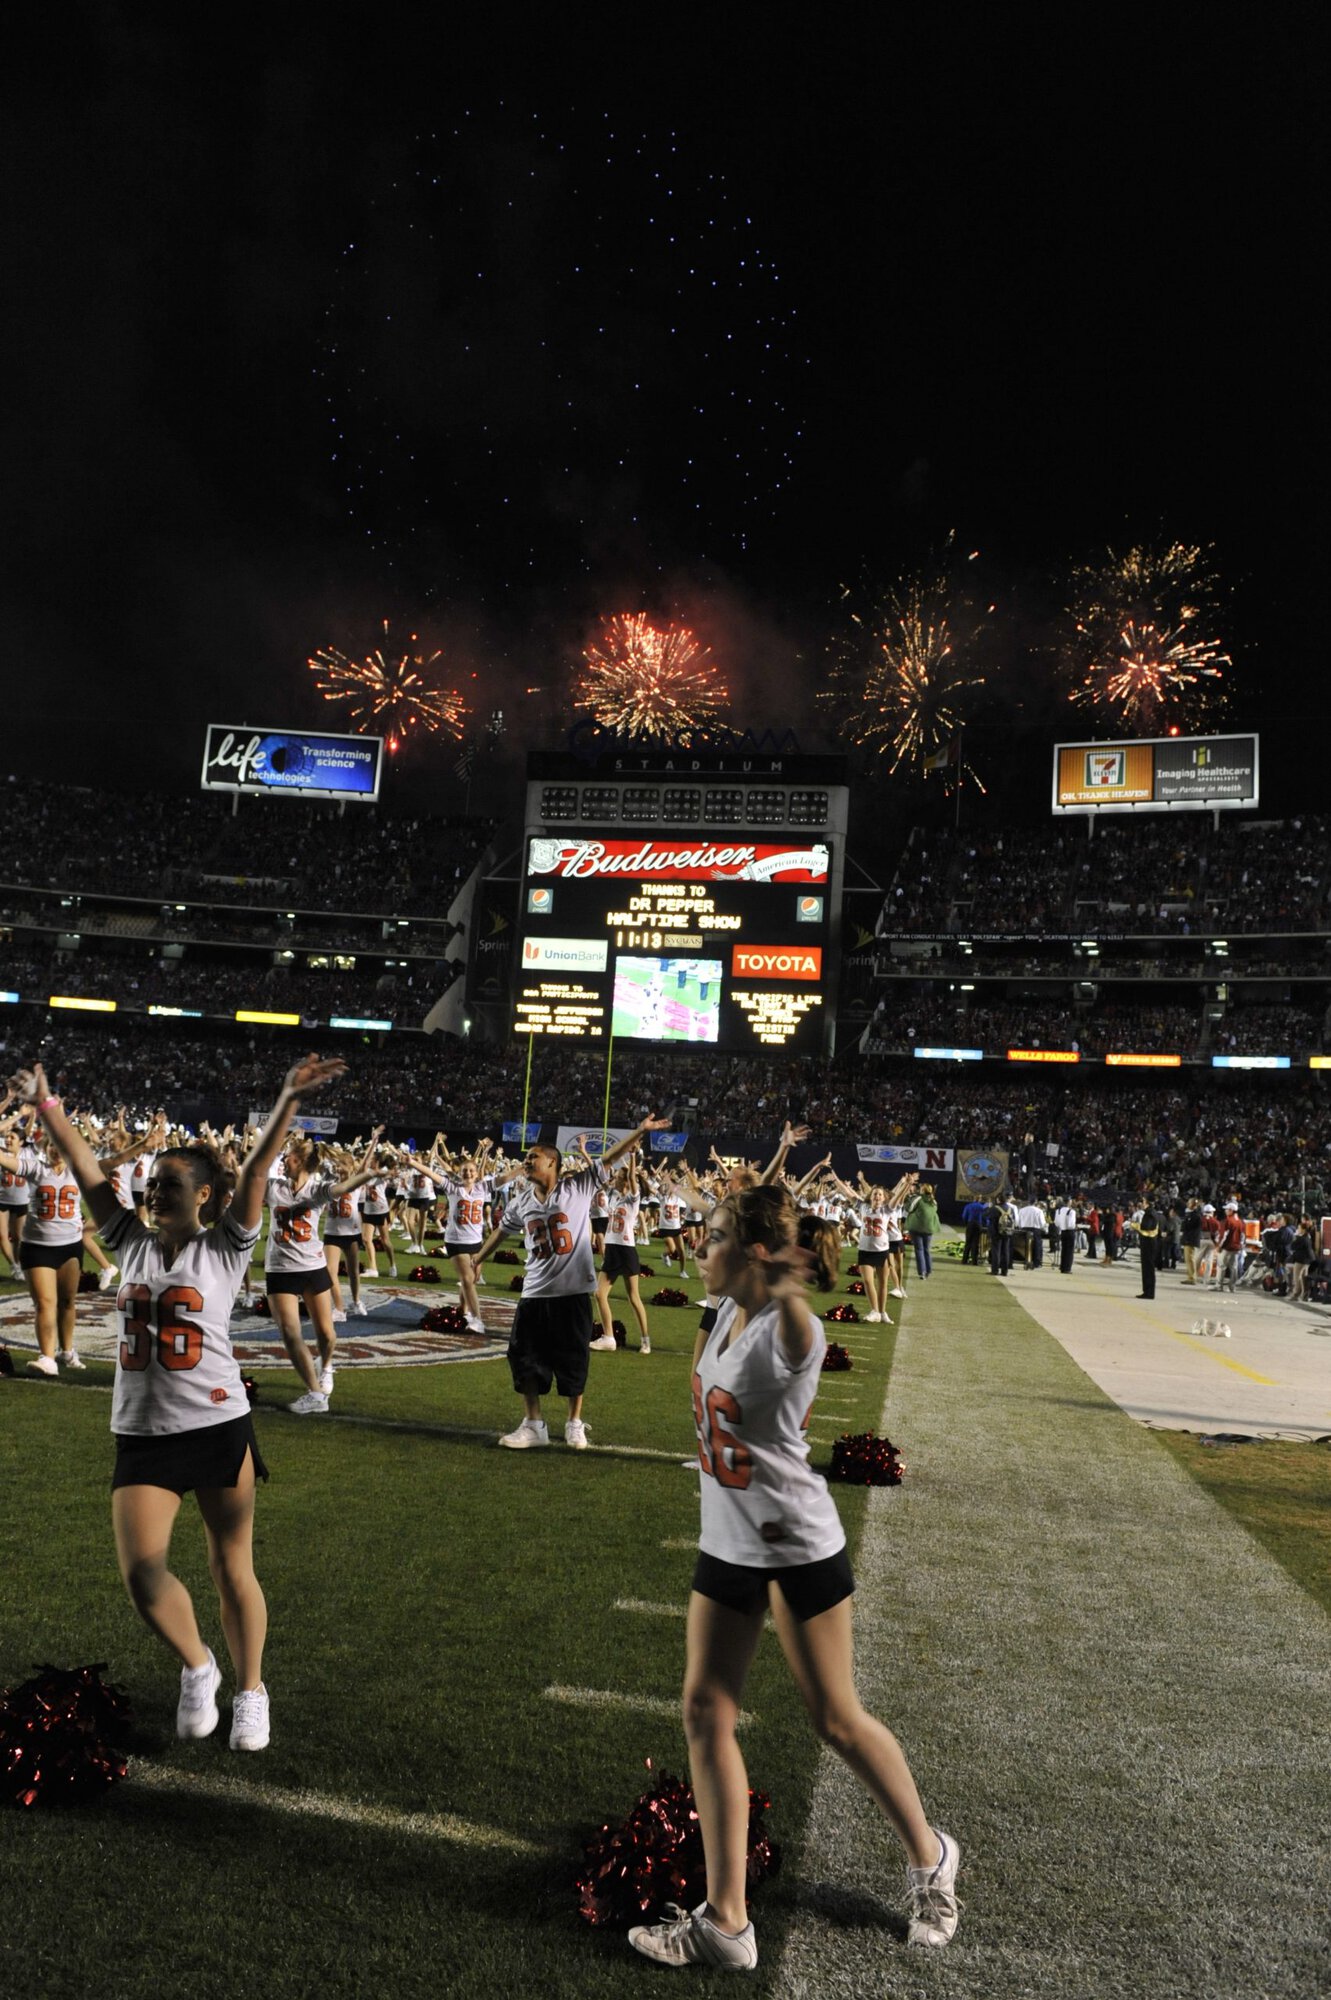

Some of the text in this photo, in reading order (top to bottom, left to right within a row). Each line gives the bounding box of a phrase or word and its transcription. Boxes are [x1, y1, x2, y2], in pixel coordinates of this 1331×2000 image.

[208, 733, 267, 782] life
[302, 746, 372, 761] Transforming
[317, 758, 355, 768] science
[615, 760, 783, 772] STADIUM
[248, 770, 312, 784] technologies
[1157, 767, 1251, 780] Imaging Healthcare
[1162, 786, 1178, 794] Your
[1179, 785, 1206, 793] Partner
[1217, 784, 1242, 793] Health
[557, 842, 756, 878] Budweiser
[758, 857, 825, 874] American Lager
[641, 883, 706, 897] THANKS TO
[629, 897, 715, 913] DR PEPPER
[606, 912, 741, 929] HALFTIME SHOW
[737, 954, 817, 973] TOYOTA
[752, 992, 795, 1003] PACIFIC
[1010, 1051, 1078, 1062] WELLS FARGO
[925, 1149, 947, 1169] N
[36, 1183, 79, 1220] 36
[457, 1199, 483, 1226] 36
[273, 1205, 312, 1243] 36
[863, 1216, 882, 1238] 36
[527, 1211, 574, 1260] 36
[117, 1282, 204, 1372] 36
